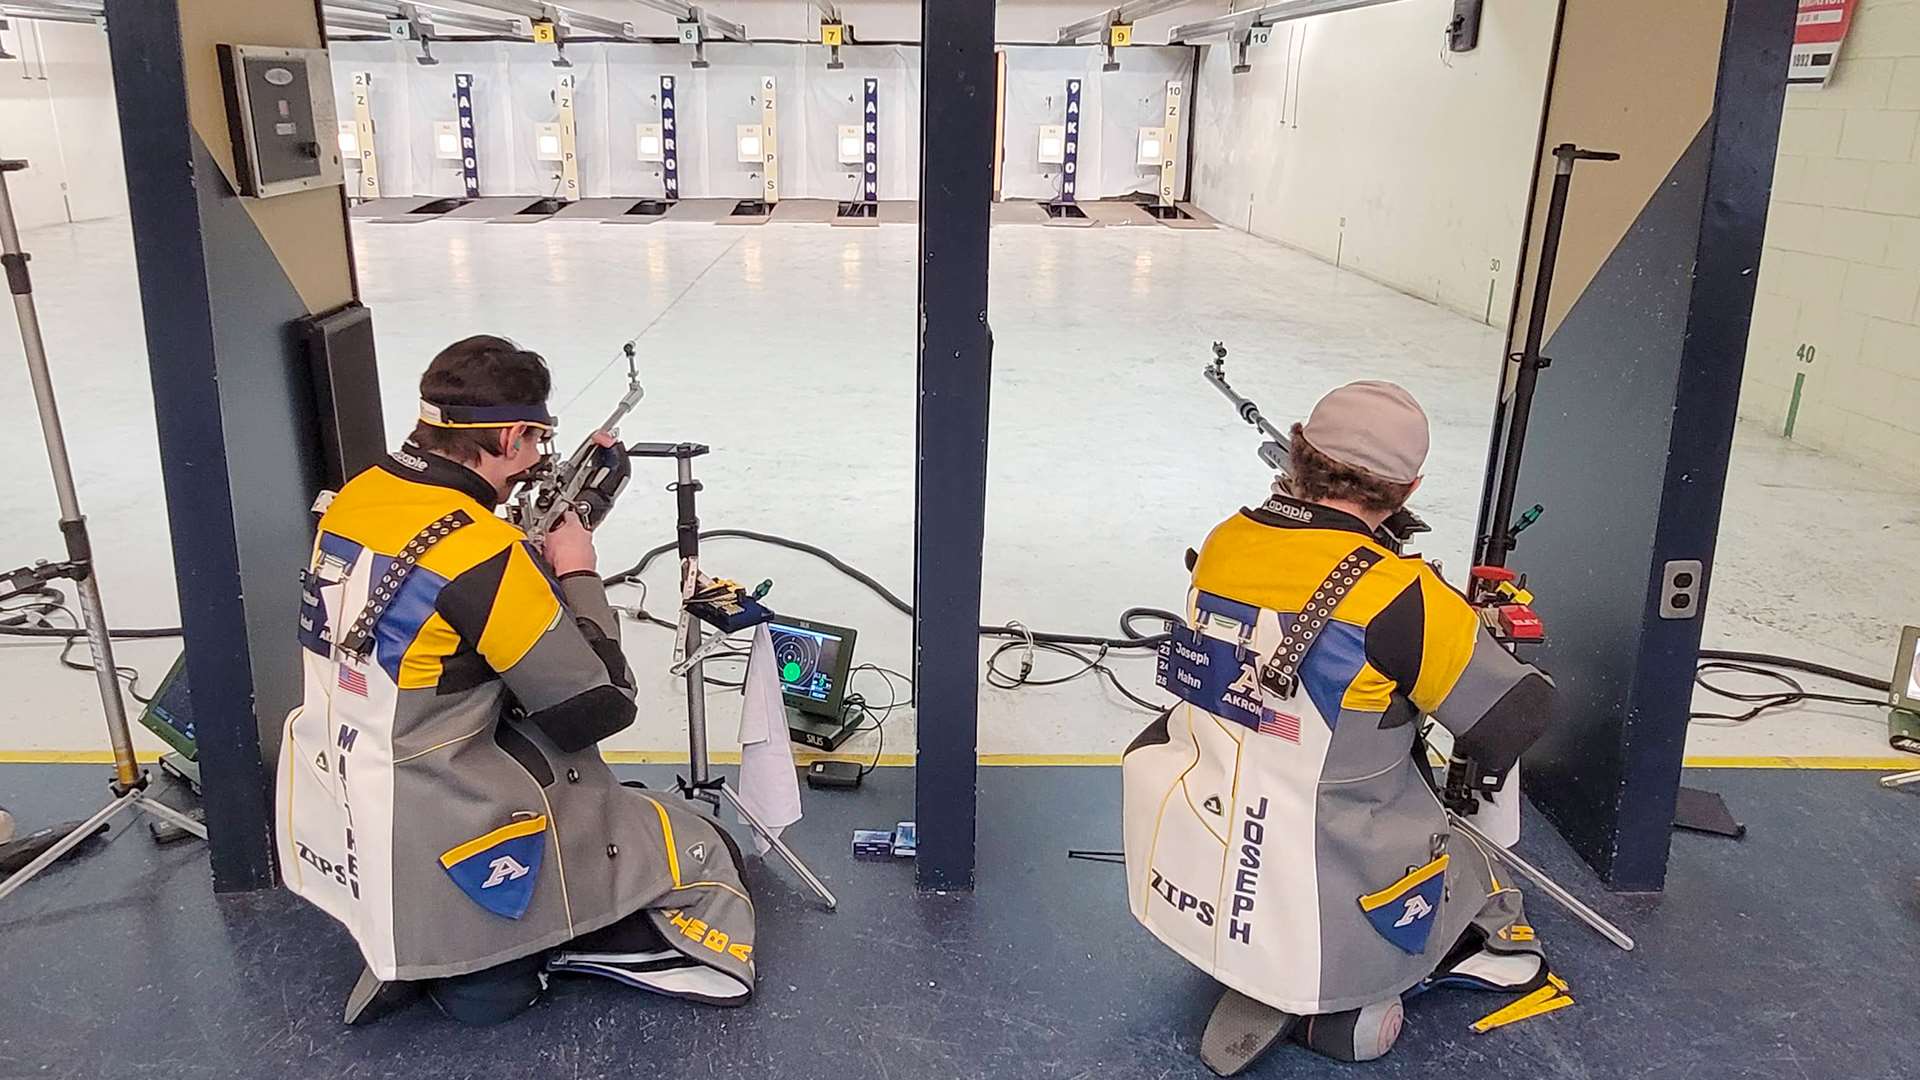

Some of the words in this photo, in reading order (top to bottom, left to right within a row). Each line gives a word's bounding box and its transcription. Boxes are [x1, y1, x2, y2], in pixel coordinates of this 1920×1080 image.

[396, 25, 404, 35] 4
[540, 29, 548, 39] 5
[685, 30, 693, 39] 6
[828, 31, 836, 40] 7
[1117, 32, 1125, 42] 9
[1253, 33, 1267, 43] 10
[355, 76, 363, 85] 2
[457, 76, 468, 87] 3
[561, 78, 569, 88] 4
[662, 78, 672, 89] 5
[765, 80, 773, 89] 6
[867, 82, 875, 93] 7
[1070, 82, 1080, 94] 9
[1169, 86, 1181, 96] 10
[357, 96, 375, 187] ZIPS
[458, 96, 478, 189] AKRON
[562, 98, 576, 189] ZIPS
[662, 98, 677, 190] AKRON
[765, 100, 775, 190] ZIPS
[866, 102, 877, 193] AKRON
[1064, 103, 1079, 193] AKRON
[1163, 106, 1177, 196] ZIPS
[1490, 258, 1500, 272] 30
[1797, 343, 1815, 363] 40
[1175, 641, 1210, 666] Joseph
[1177, 668, 1202, 690] Hahn
[1892, 692, 1900, 705] 9
[296, 841, 347, 887] ZIPS
[1229, 797, 1269, 945] JOSEPH
[1151, 868, 1216, 927] ZIPS
